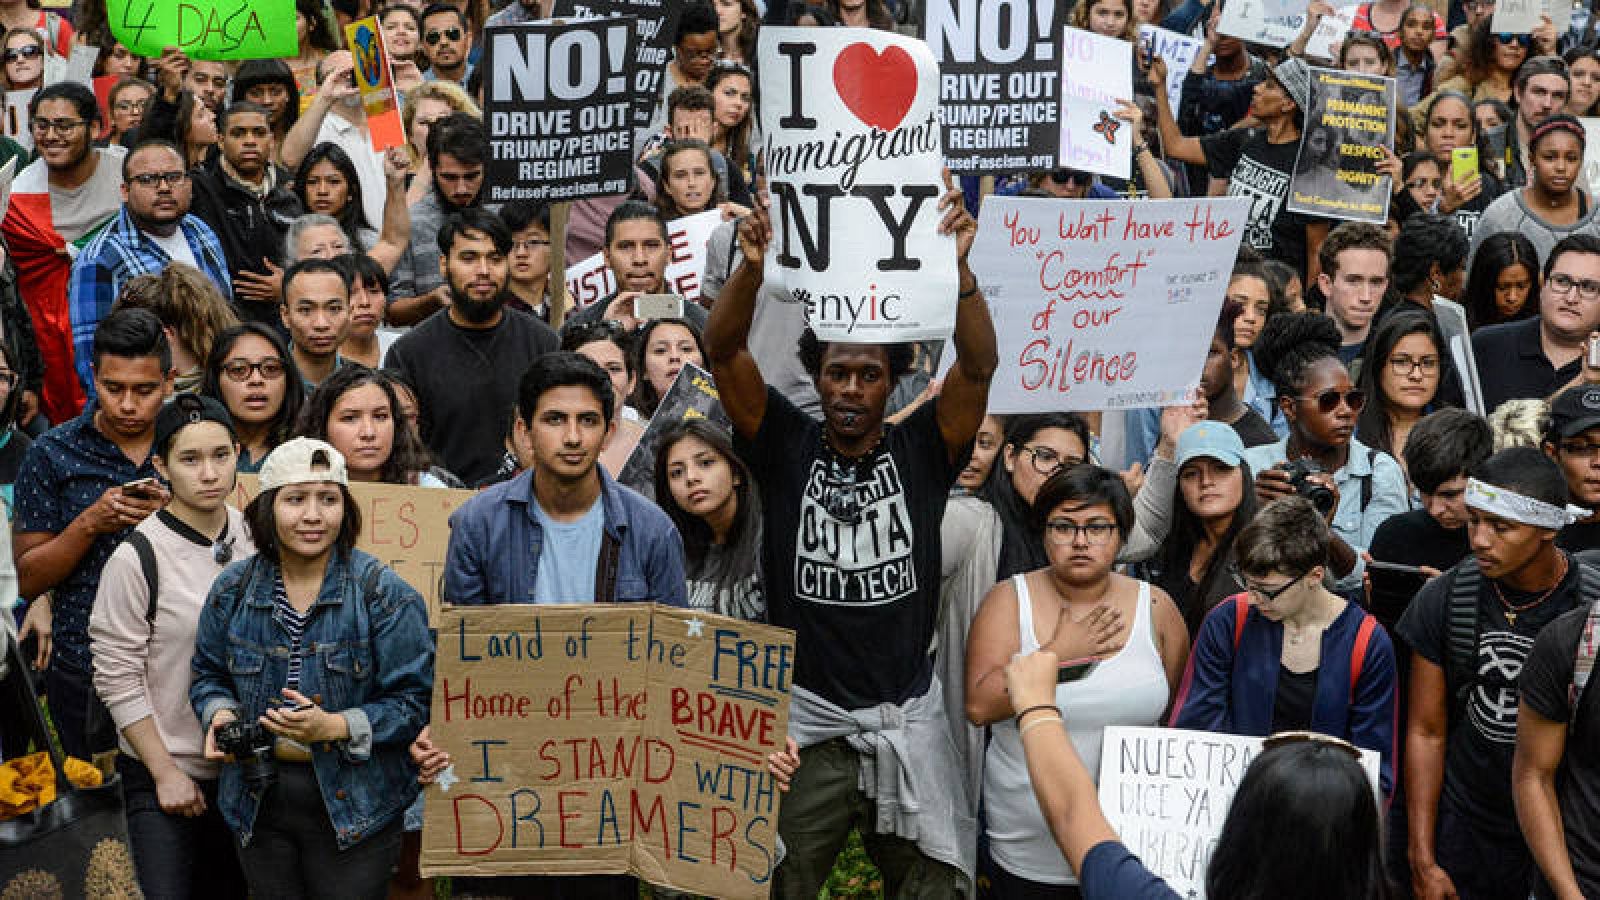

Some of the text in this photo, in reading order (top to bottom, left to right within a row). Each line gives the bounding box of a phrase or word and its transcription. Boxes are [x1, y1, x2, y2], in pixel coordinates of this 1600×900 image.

[925, 0, 1055, 64] NO!
[493, 25, 628, 101] NO!
[778, 42, 816, 129] I
[941, 73, 1001, 101] RIVE
[1008, 71, 1057, 99] OUT
[491, 109, 571, 137] DRIVE
[579, 102, 631, 132] OUT
[938, 101, 1057, 127] RUMP/PENCE
[490, 131, 631, 161] TRUMP/PENCE
[949, 127, 1029, 149] REGIME!
[491, 180, 627, 200] RefuseFascism.org
[518, 156, 601, 182] REGIME!
[770, 181, 939, 273] NY
[1003, 207, 1041, 247] You
[1122, 204, 1175, 241] have
[1184, 203, 1235, 243] the
[819, 283, 901, 335] nyic
[1031, 299, 1123, 331] of our
[1019, 337, 1137, 393] Silence
[801, 560, 849, 600] CITY
[853, 558, 912, 601] TECH
[459, 615, 793, 694] Land of the FREE
[443, 674, 777, 747] Home of the BRAVE
[470, 736, 776, 814] I STAND WITH
[1119, 783, 1212, 826] DICE YA
[453, 788, 773, 884] DREAMERS
